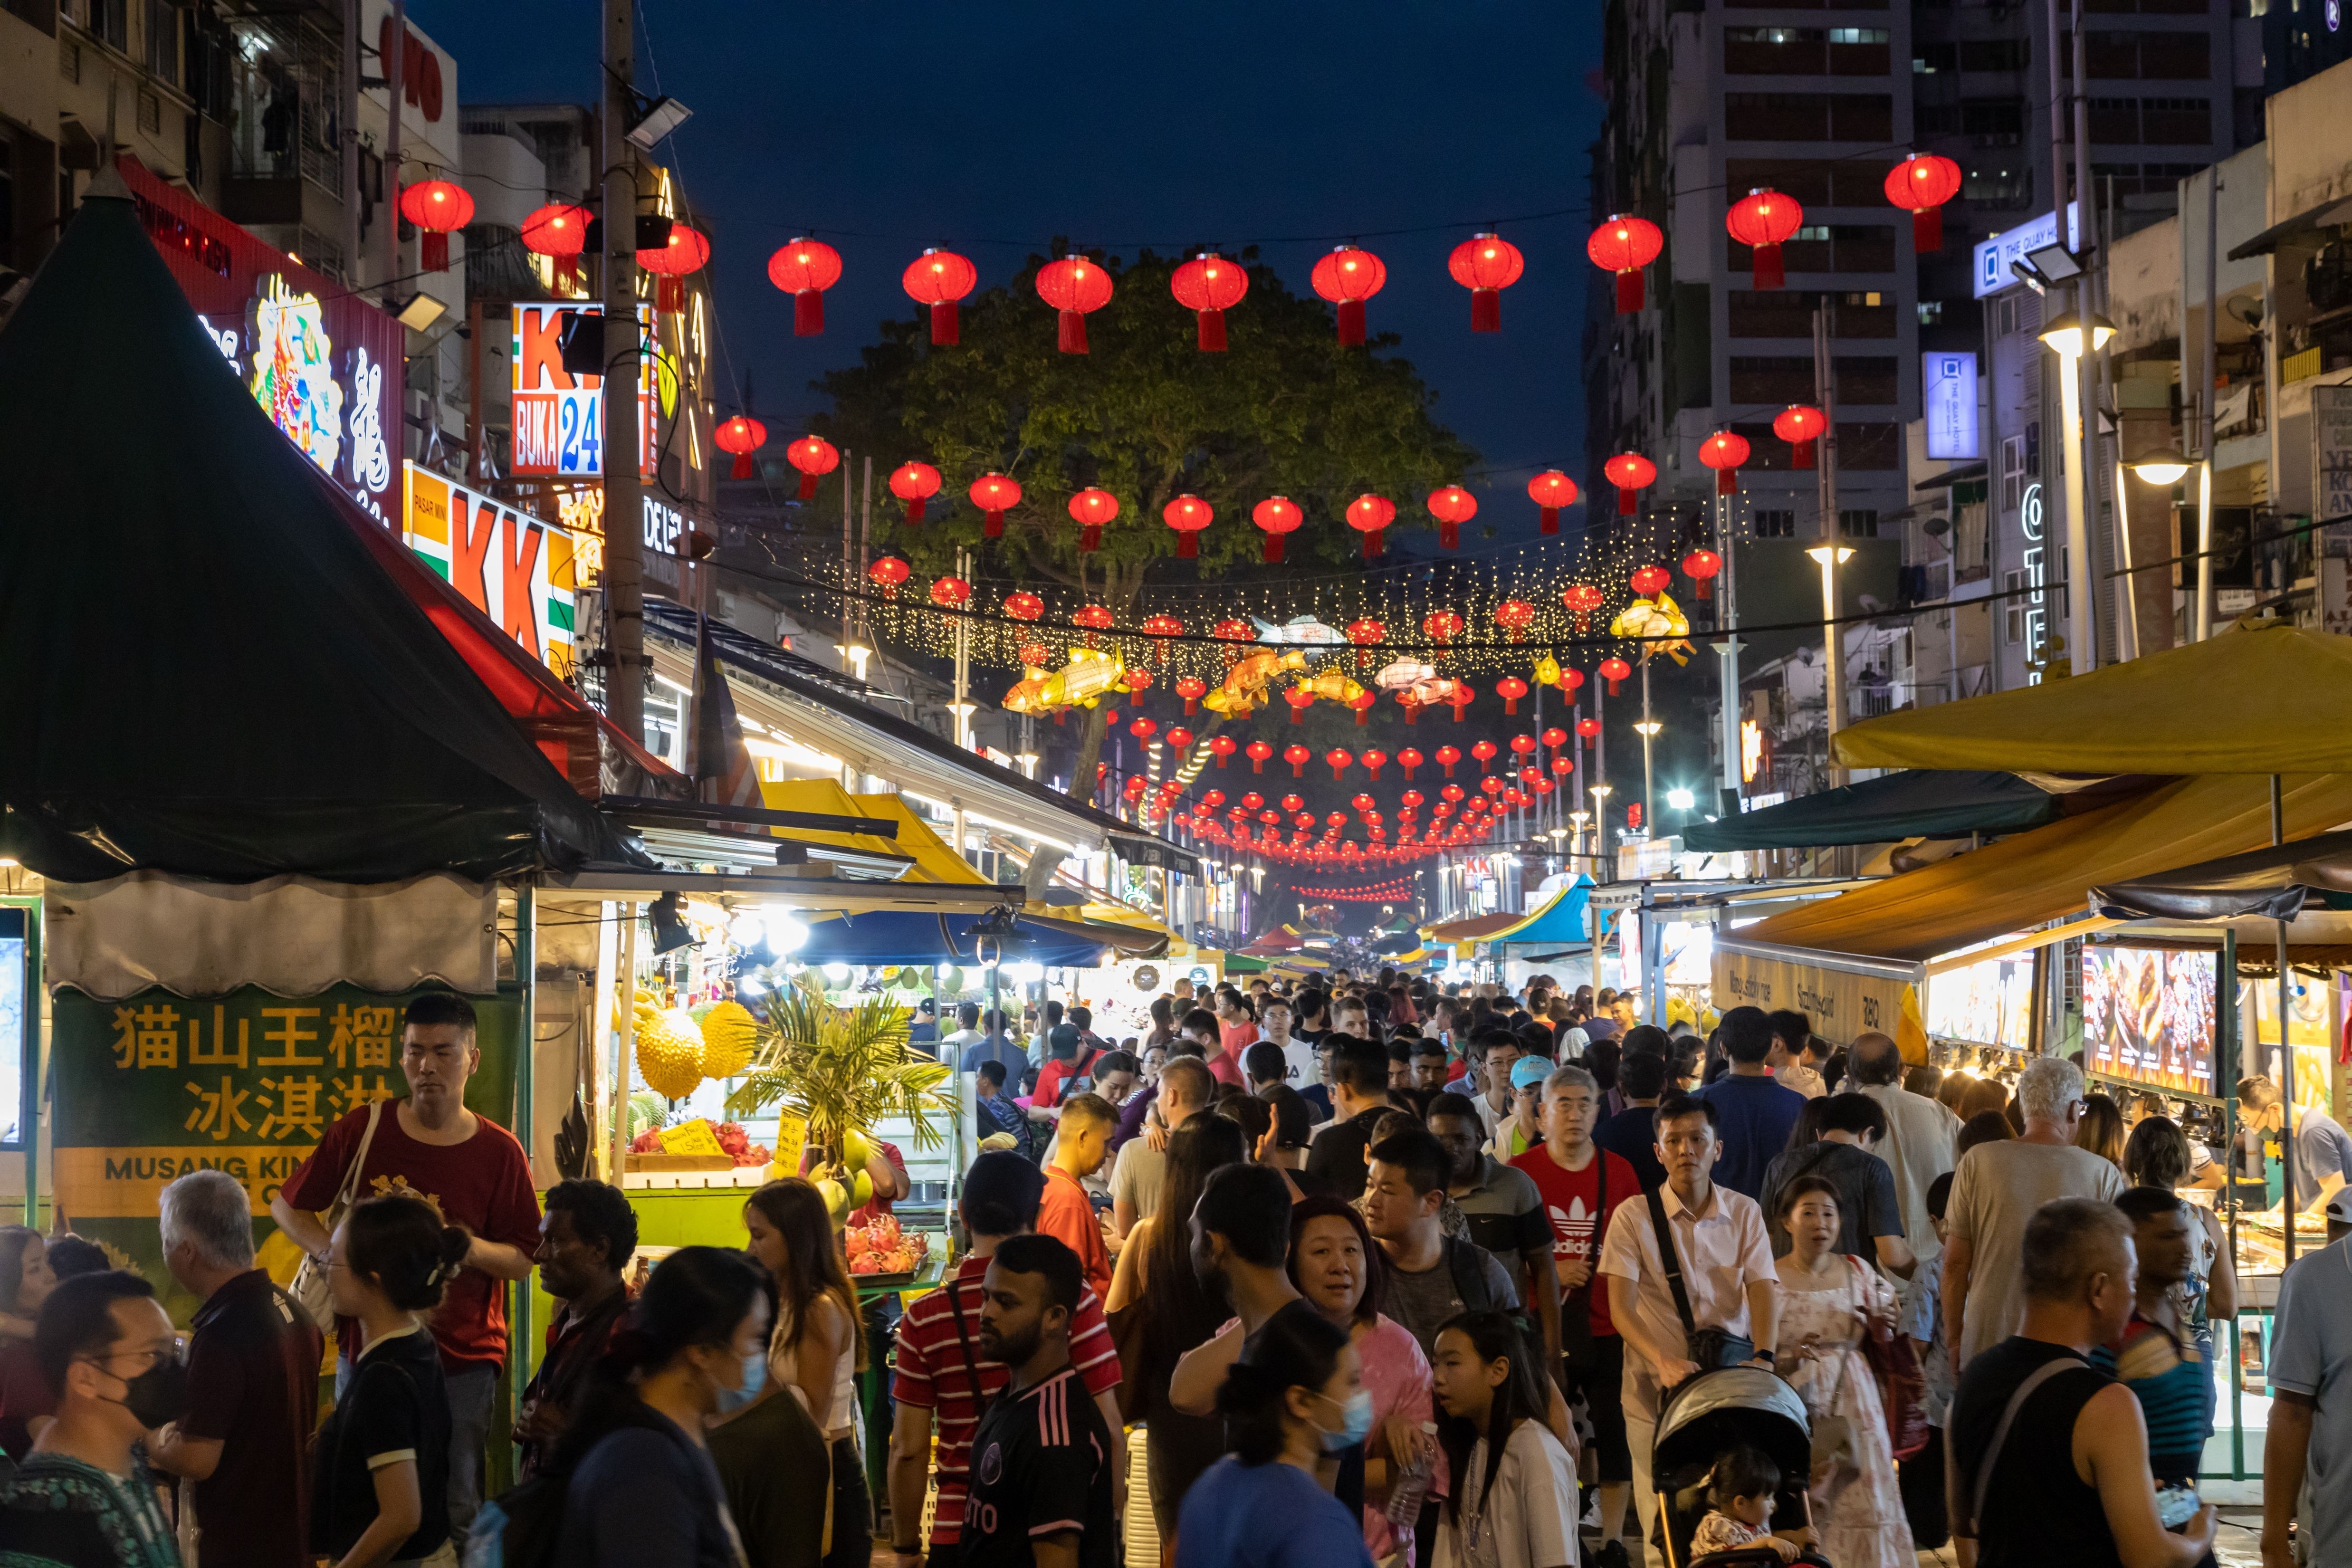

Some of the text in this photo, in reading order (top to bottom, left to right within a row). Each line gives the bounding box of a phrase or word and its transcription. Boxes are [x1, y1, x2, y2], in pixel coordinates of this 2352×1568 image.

[2006, 241, 2021, 258] THE
[2024, 228, 2046, 249] QUAY
[650, 340, 658, 474] SUPERMART
[516, 401, 557, 466] BUKA
[561, 397, 599, 471] 24
[414, 494, 434, 517] PASAR
[452, 488, 544, 661] KK
[1466, 856, 1490, 873] KK
[112, 1004, 405, 1069] 猫山王榴
[684, 1124, 702, 1136] FRUIT
[105, 1157, 248, 1180] MUSANG
